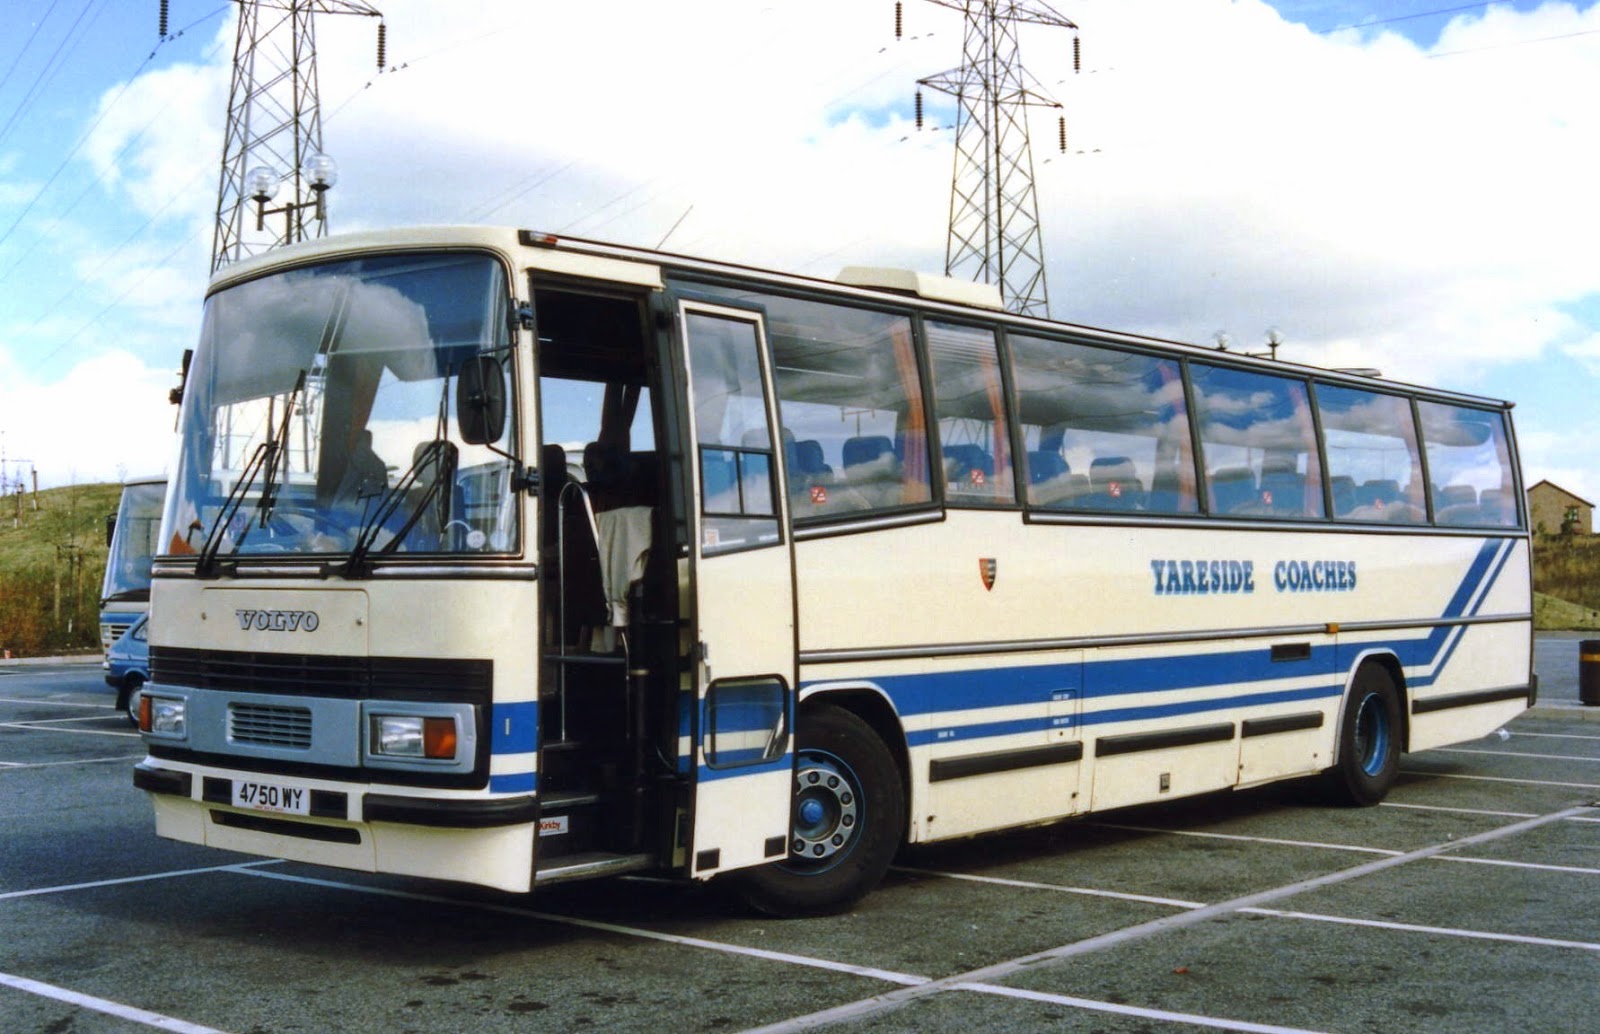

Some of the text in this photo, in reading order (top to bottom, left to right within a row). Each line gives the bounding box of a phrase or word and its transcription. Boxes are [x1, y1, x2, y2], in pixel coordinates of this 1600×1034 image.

[1151, 560, 1357, 595] YARESIDE COACHES
[235, 610, 319, 632] VOLVO
[240, 783, 302, 809] 4750 WY
